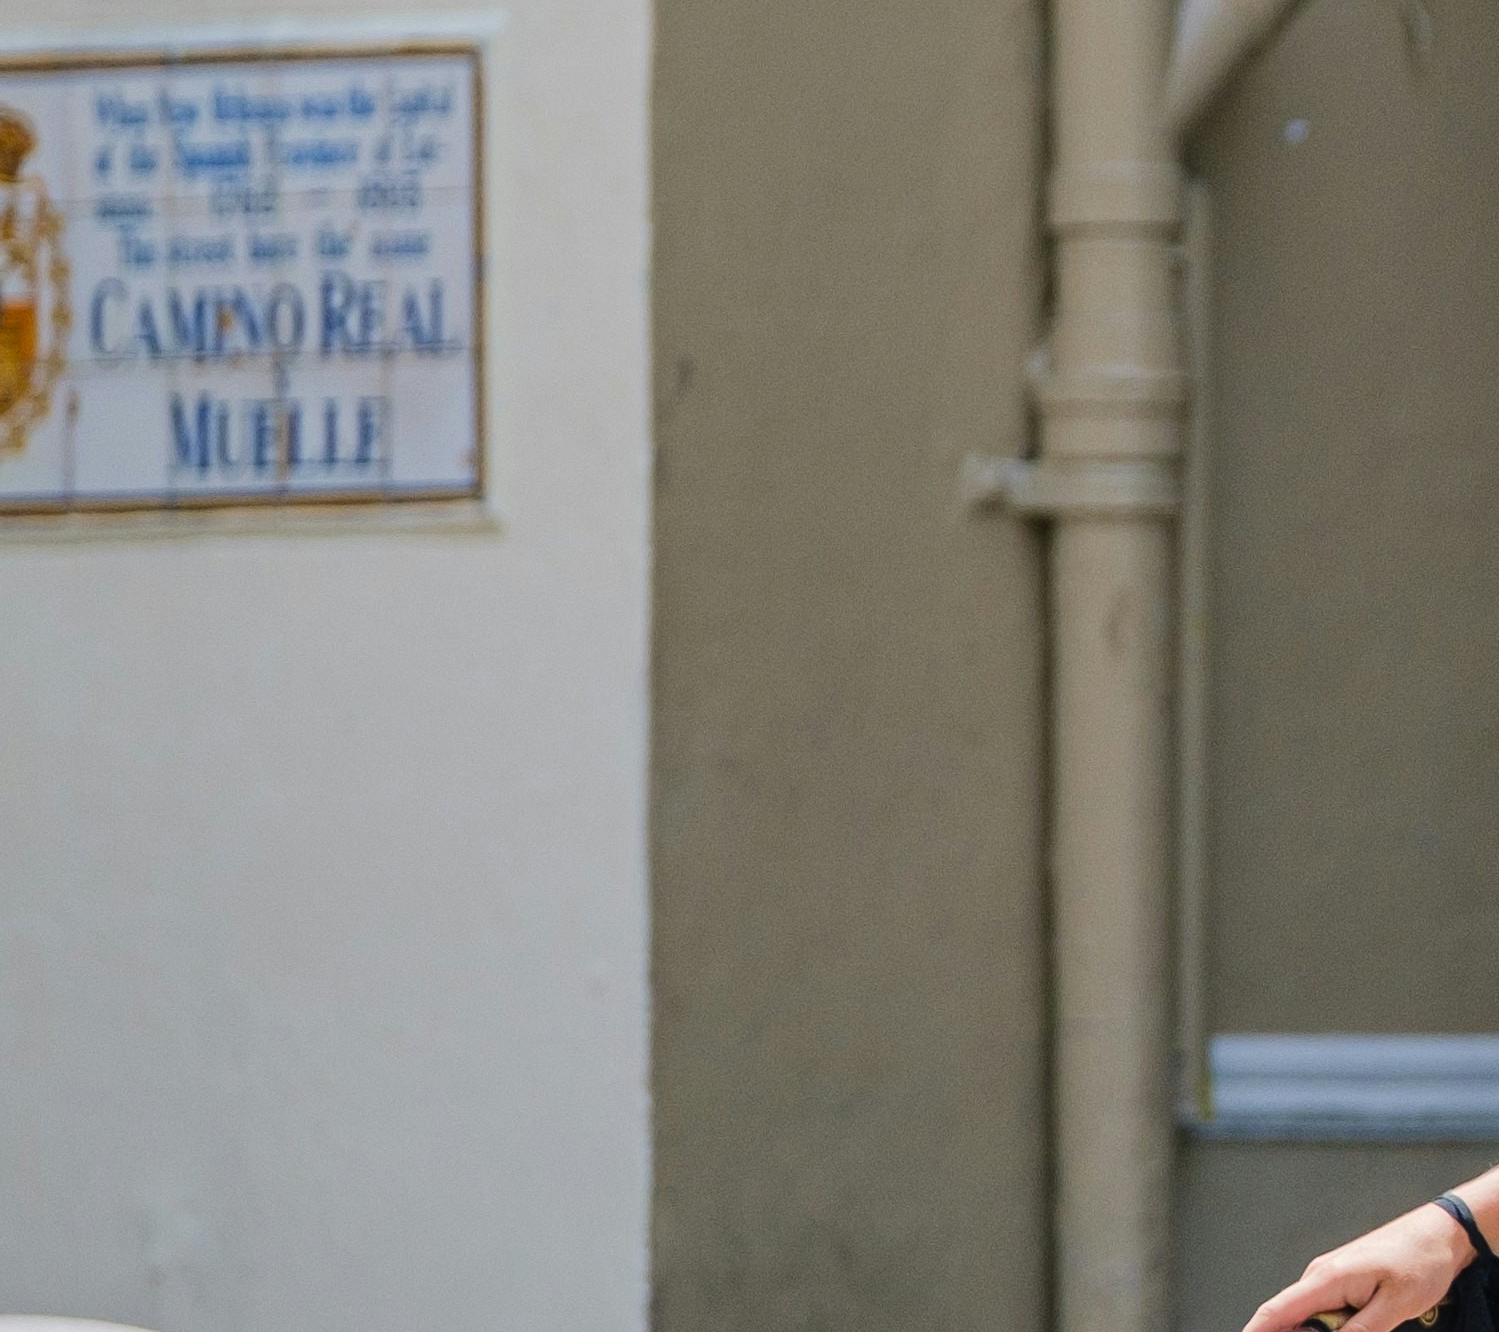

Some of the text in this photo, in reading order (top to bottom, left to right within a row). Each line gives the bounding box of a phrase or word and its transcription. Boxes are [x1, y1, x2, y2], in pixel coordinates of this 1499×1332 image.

[90, 269, 461, 360] CAMINO REAL
[168, 386, 388, 476] MUELLE
